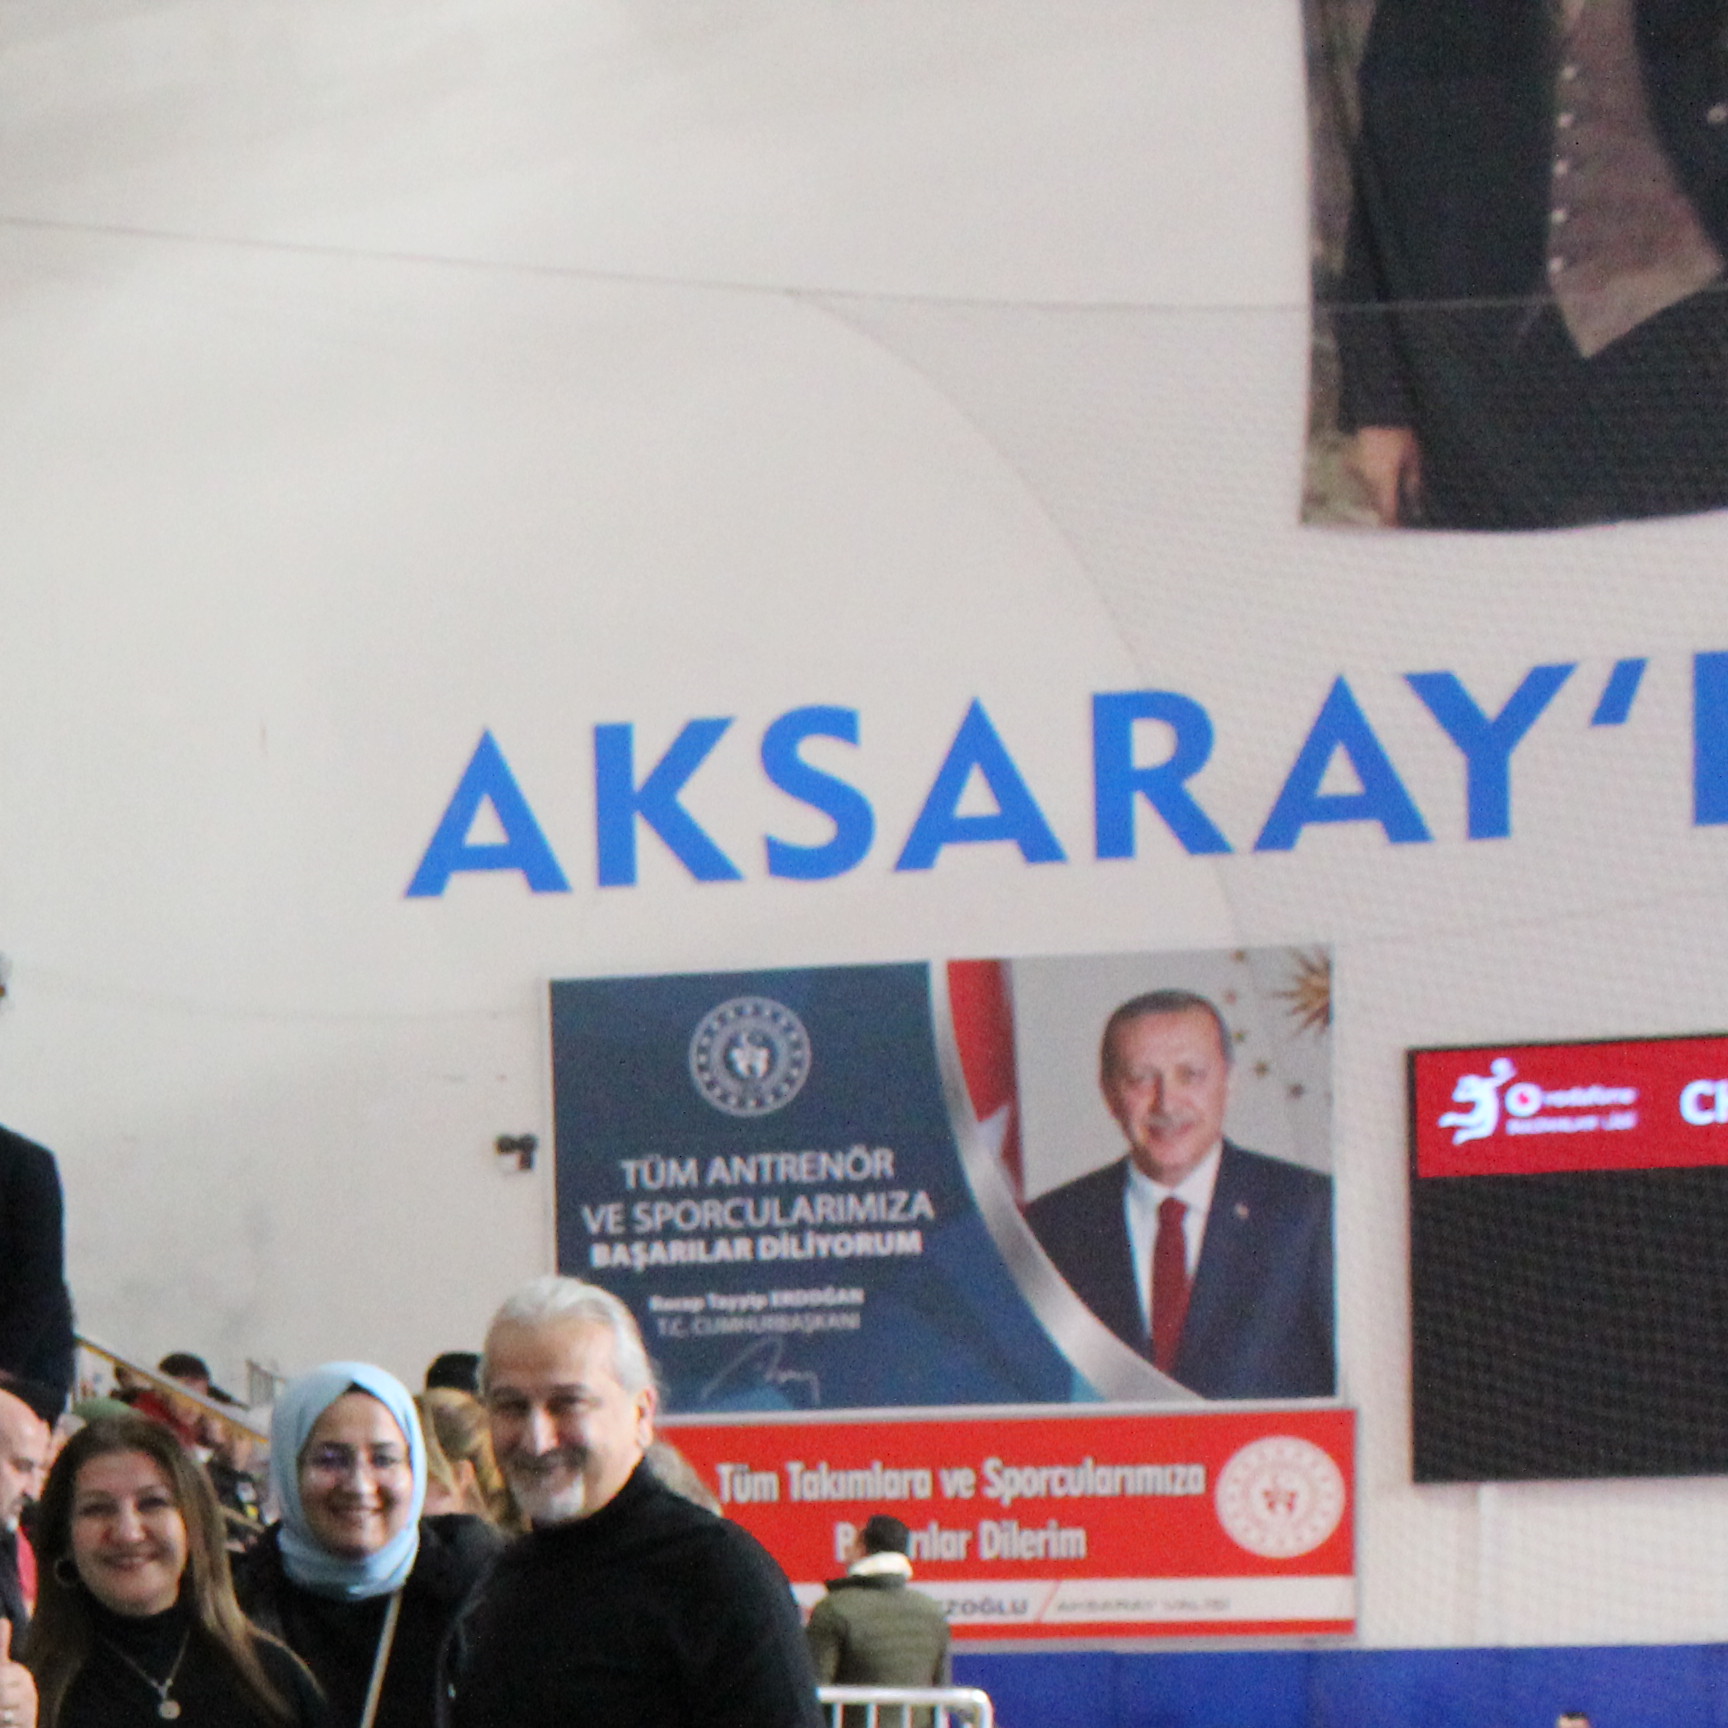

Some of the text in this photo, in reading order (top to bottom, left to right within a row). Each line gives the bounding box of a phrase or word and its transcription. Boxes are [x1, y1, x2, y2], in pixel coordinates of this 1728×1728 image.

[620, 1144, 896, 1190] TÜM ANTRENÖR
[582, 1190, 936, 1235] VE SPORCULARIMIZA
[590, 1229, 924, 1272] BAŞARILAR DİLİYORUM
[717, 1457, 1206, 1507] Tüm Takımlara ve Sporcularımıza
[835, 1519, 1088, 1563] Brılar Dilerim
